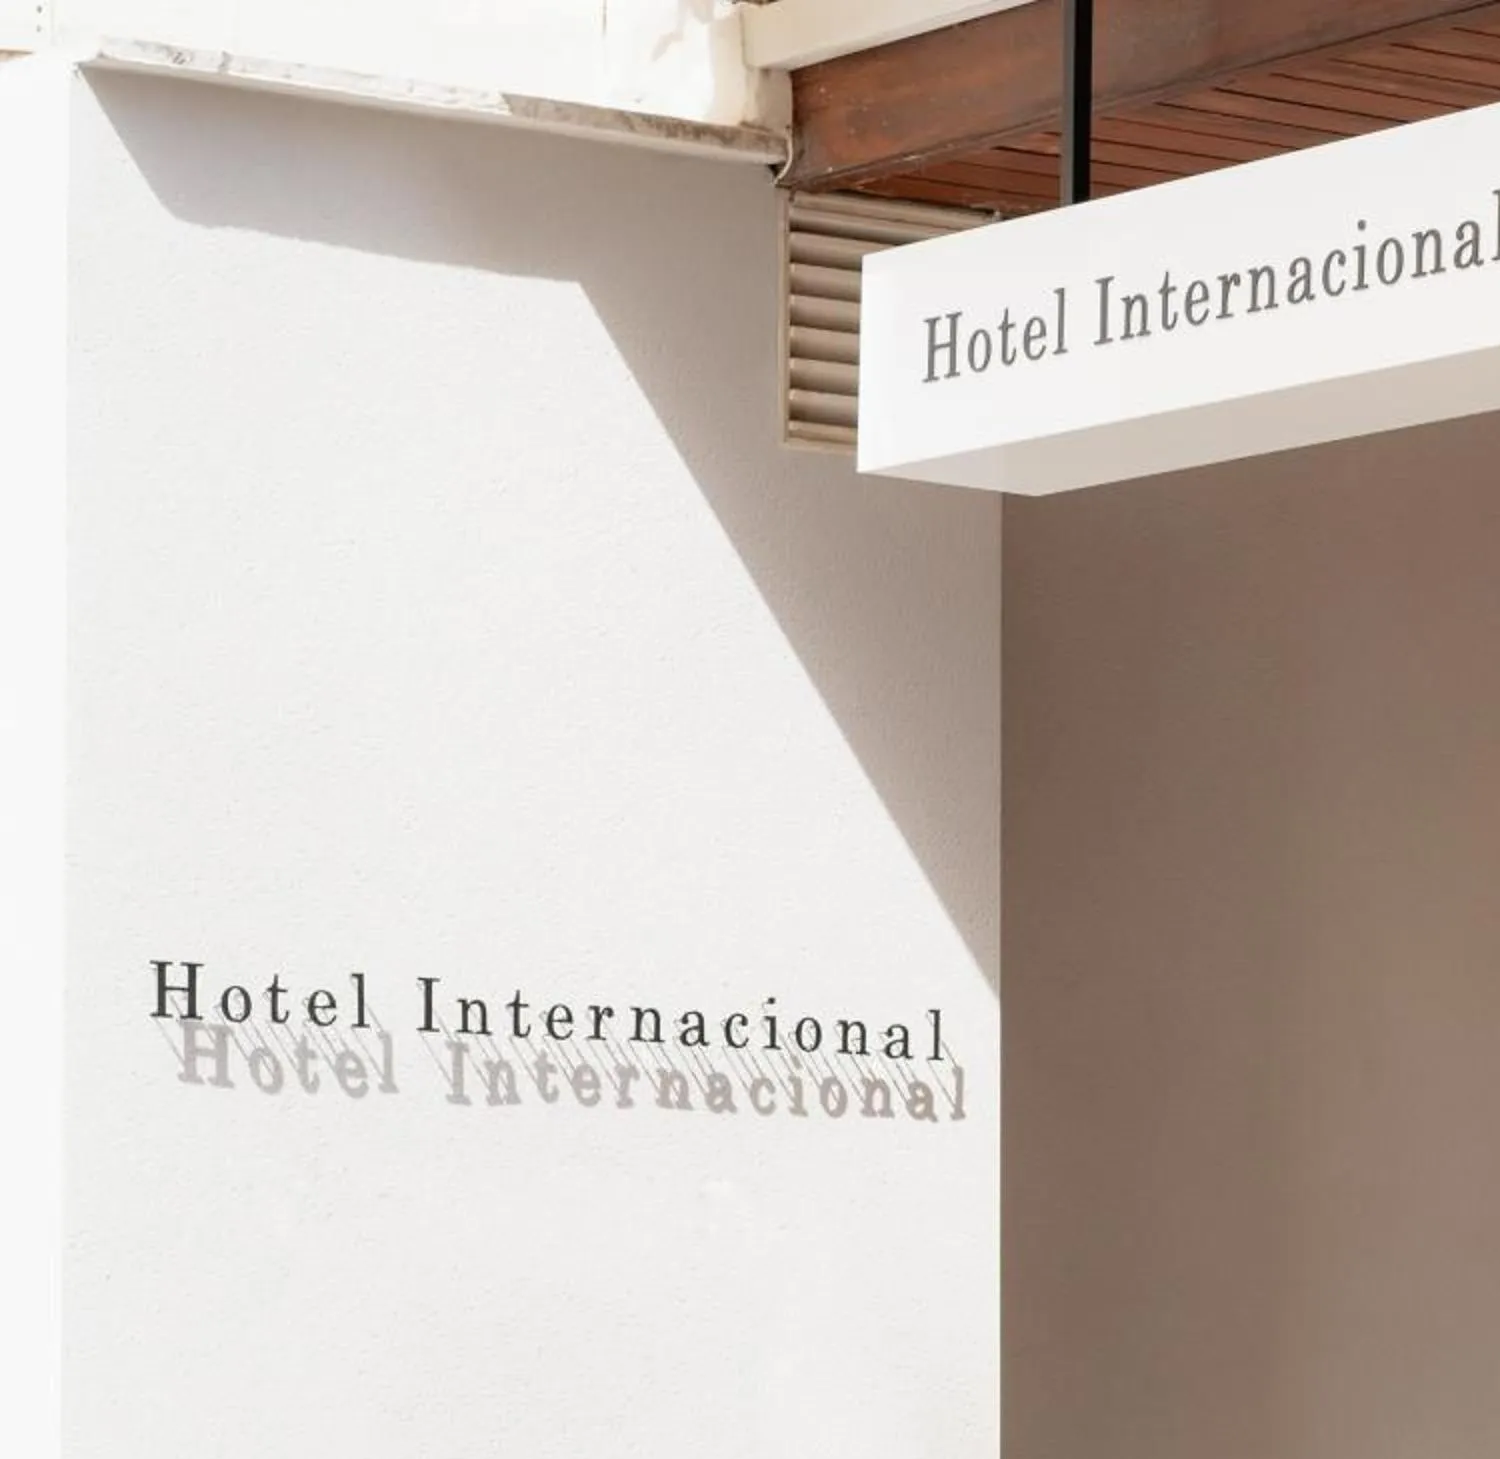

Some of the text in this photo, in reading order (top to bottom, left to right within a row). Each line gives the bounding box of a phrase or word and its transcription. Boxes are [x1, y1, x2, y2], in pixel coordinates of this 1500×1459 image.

[921, 287, 1069, 384] Hotel
[149, 960, 945, 1062] Hotel Internacional
